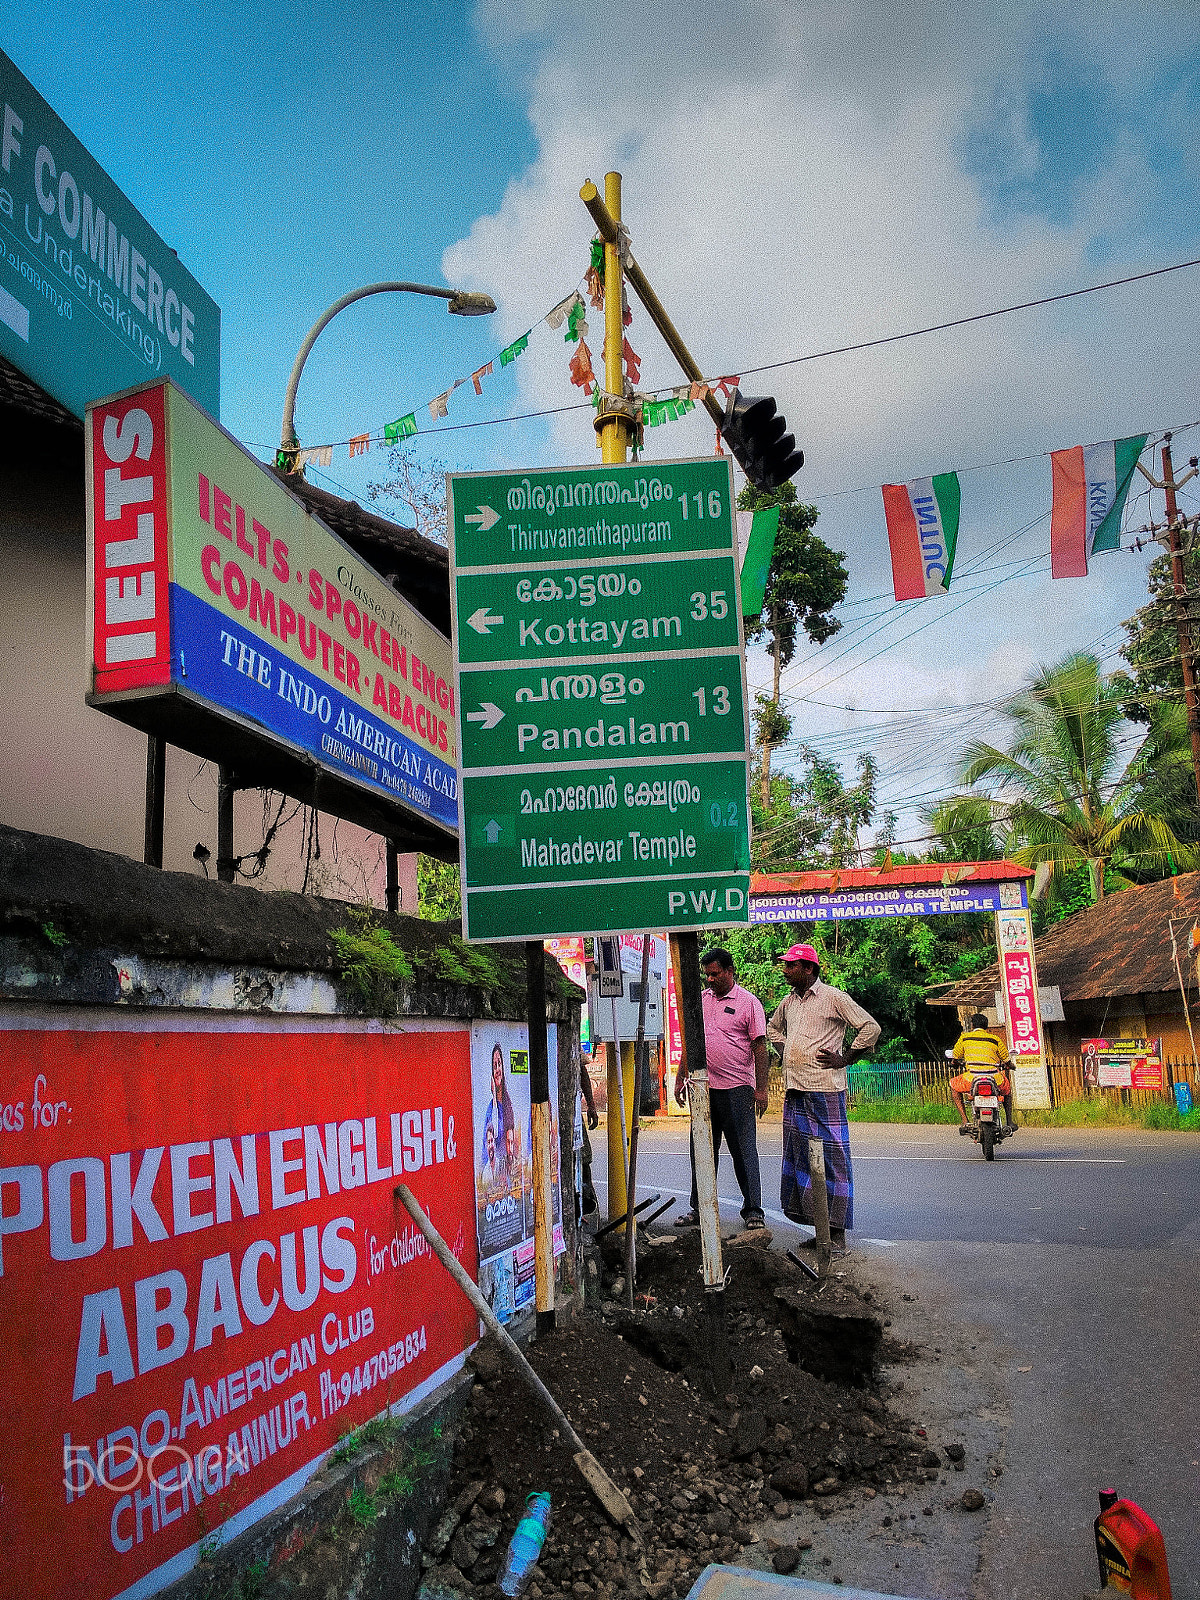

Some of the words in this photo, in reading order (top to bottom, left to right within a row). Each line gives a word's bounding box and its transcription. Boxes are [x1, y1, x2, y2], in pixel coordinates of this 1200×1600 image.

[35, 145, 195, 367] COMMERCE
[24, 203, 162, 370] Undertaking)
[507, 478, 673, 516] തിരുവനന്തപുരം
[678, 490, 722, 520] 116
[103, 408, 157, 665] IELTS
[508, 519, 672, 552] Thiruvananthapuram
[338, 566, 387, 622] Classes
[516, 573, 642, 607] കോട്ടയം
[690, 590, 729, 621] 35
[308, 569, 408, 680] SPOKEN
[519, 615, 683, 648] Kottayam
[200, 544, 361, 695] COMPUTER
[372, 672, 449, 752] ABACUS
[220, 630, 273, 690] THE
[278, 675, 332, 724] INDO
[334, 707, 423, 780] AMERICAN
[515, 673, 645, 705] പന്തളം
[692, 685, 731, 716] 13
[517, 717, 690, 752] Pandalam
[520, 775, 617, 815] മഹാദേവർ
[624, 778, 701, 813] ക്ഷേത്രം
[710, 801, 739, 828] 0.2
[521, 835, 624, 868] Mahadevar
[629, 828, 697, 866] Temple
[820, 889, 899, 906] മഹാദേവർ
[832, 903, 925, 918] MAHADEVAR
[929, 899, 994, 912] TEMPLE
[270, 1107, 443, 1210] ENGLISH
[446, 1115, 458, 1160] &
[72, 1217, 357, 1402] ABACUS
